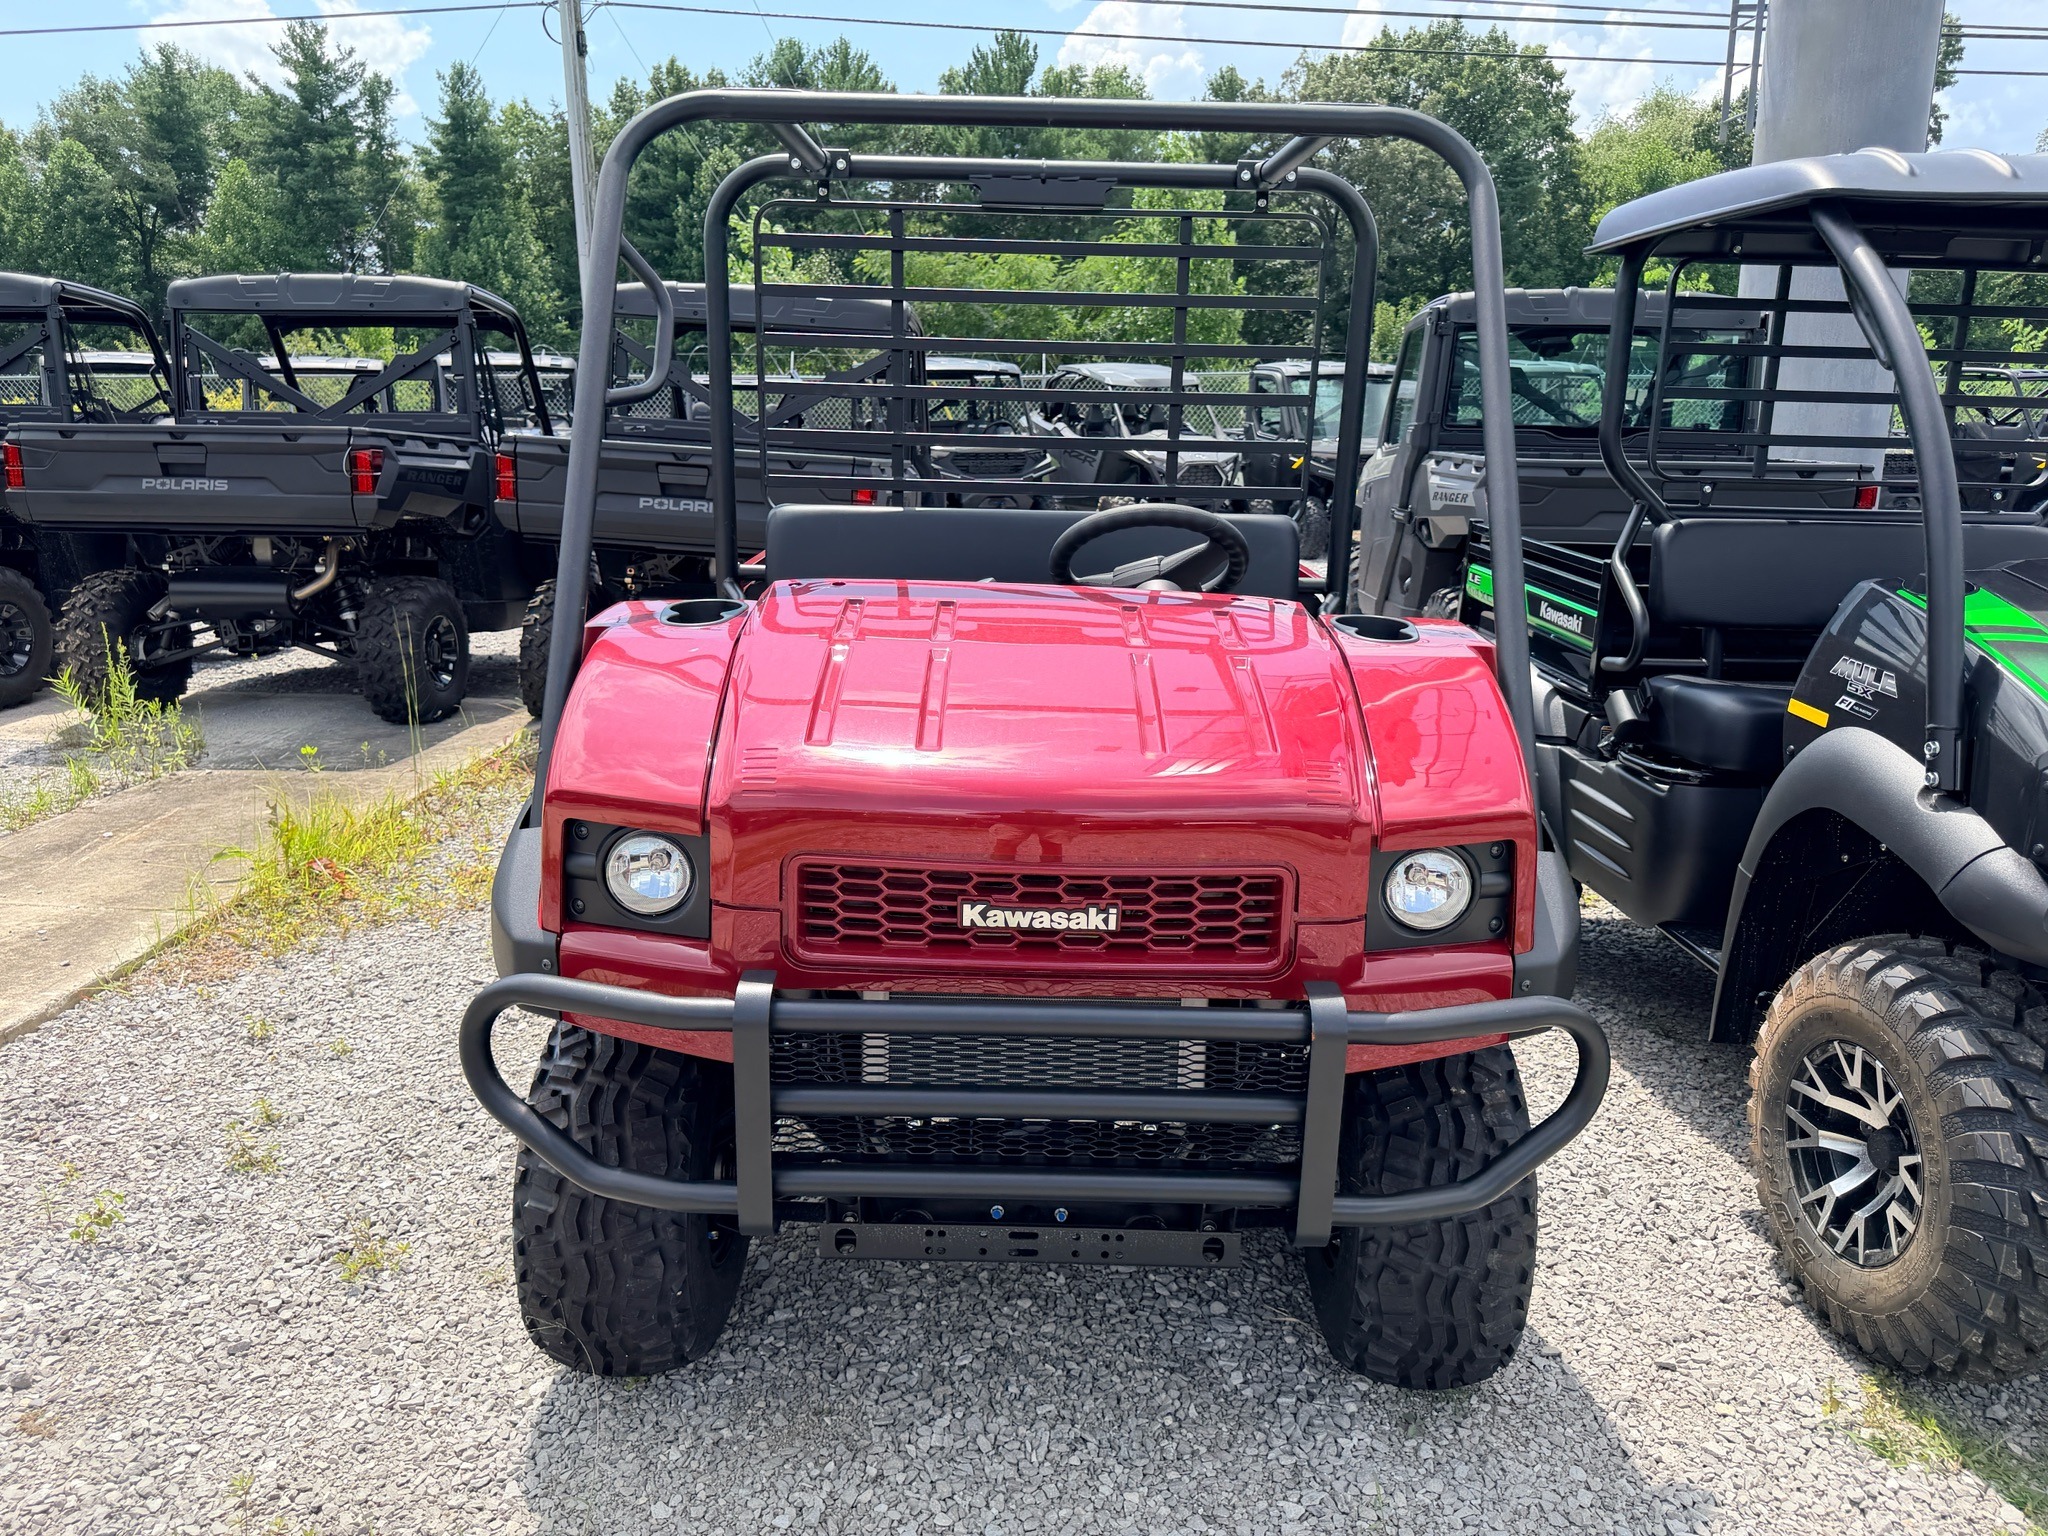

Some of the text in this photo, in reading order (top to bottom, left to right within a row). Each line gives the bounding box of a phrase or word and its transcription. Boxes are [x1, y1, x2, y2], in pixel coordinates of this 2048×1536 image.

[141, 478, 229, 491] POLARIS
[407, 469, 463, 486] RANGER
[639, 497, 714, 514] POLARI
[1432, 491, 1469, 504] RANGER
[1468, 572, 1482, 585] LE
[1540, 600, 1583, 634] Kawasaki
[1830, 655, 1898, 699] MULE
[1847, 681, 1875, 700] SX
[962, 903, 1118, 931] Kawasaki
